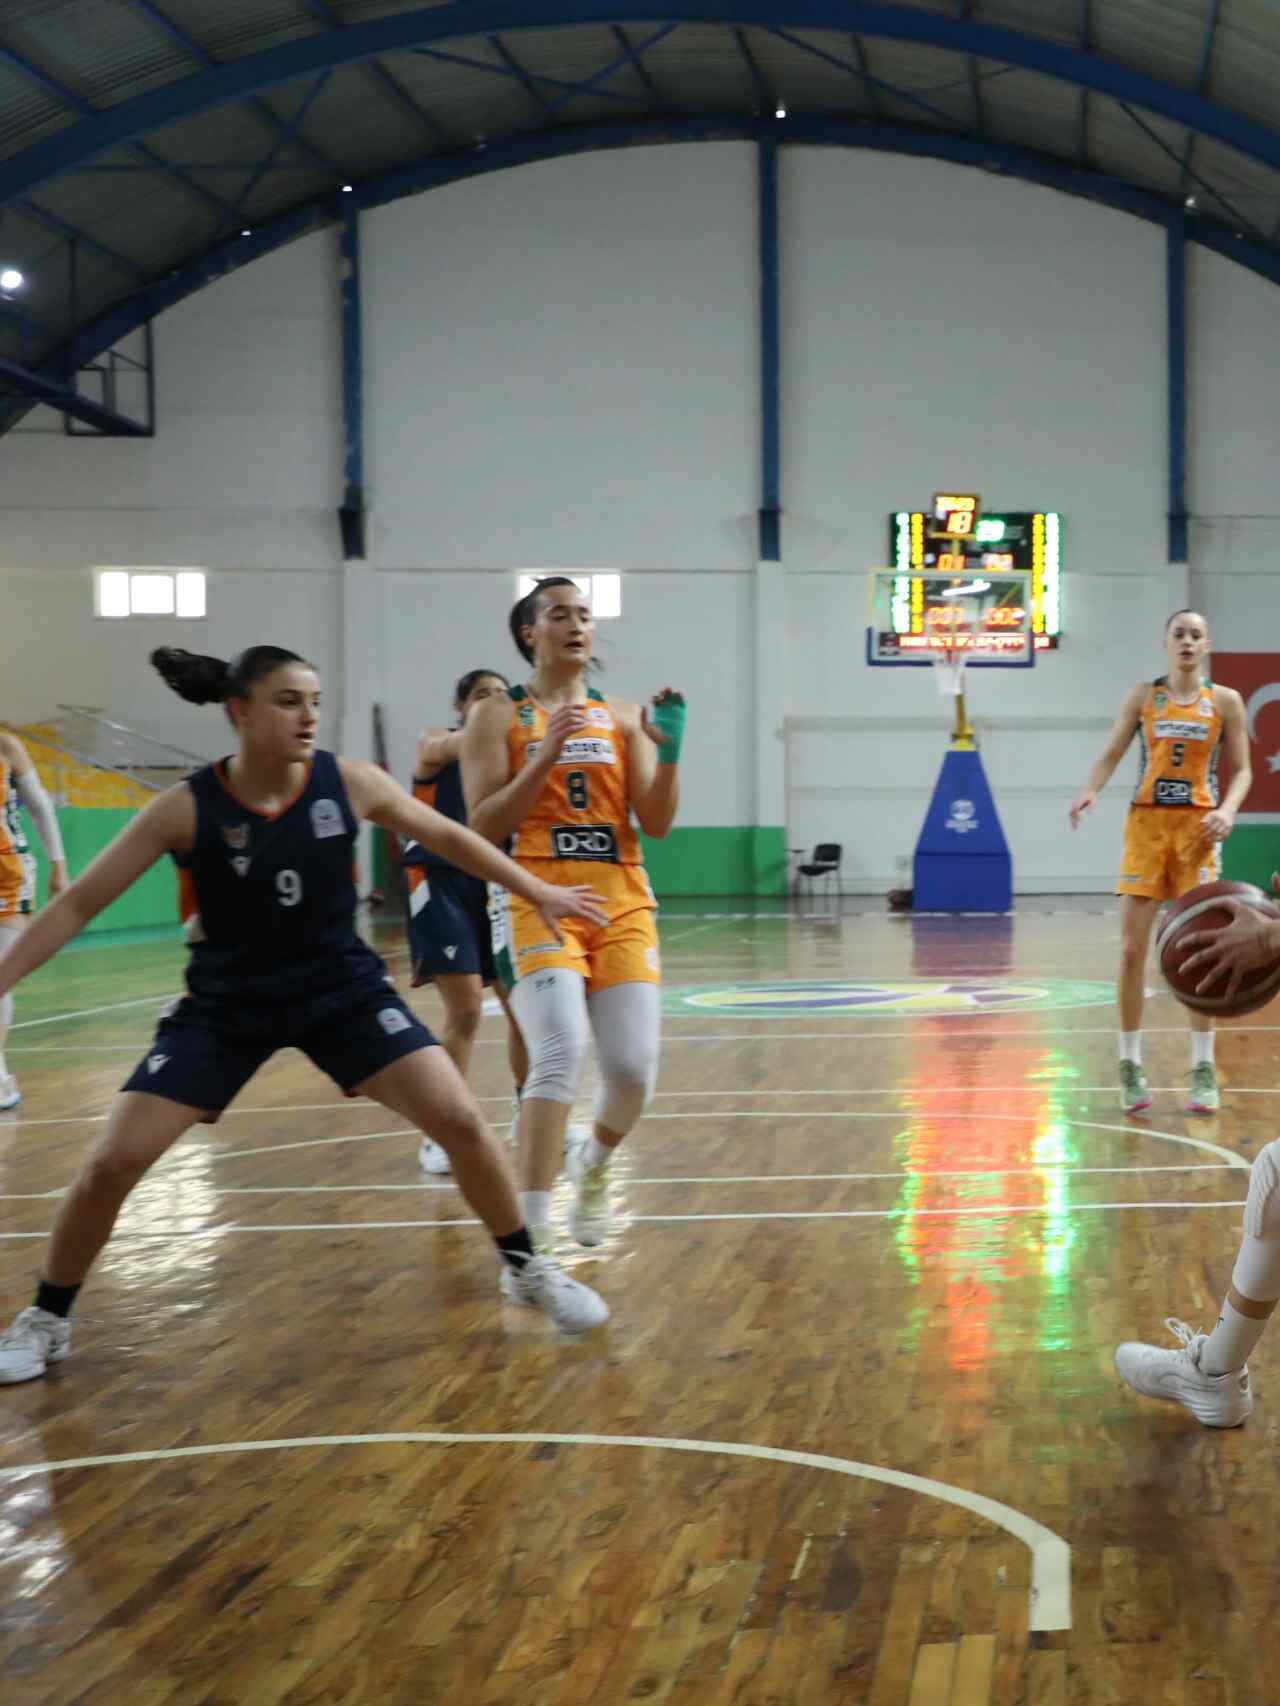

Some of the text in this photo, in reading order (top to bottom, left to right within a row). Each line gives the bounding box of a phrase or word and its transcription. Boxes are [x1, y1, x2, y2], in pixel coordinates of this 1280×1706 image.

[1172, 743, 1185, 768] 5
[567, 770, 588, 812] 8
[275, 869, 302, 907] 9
